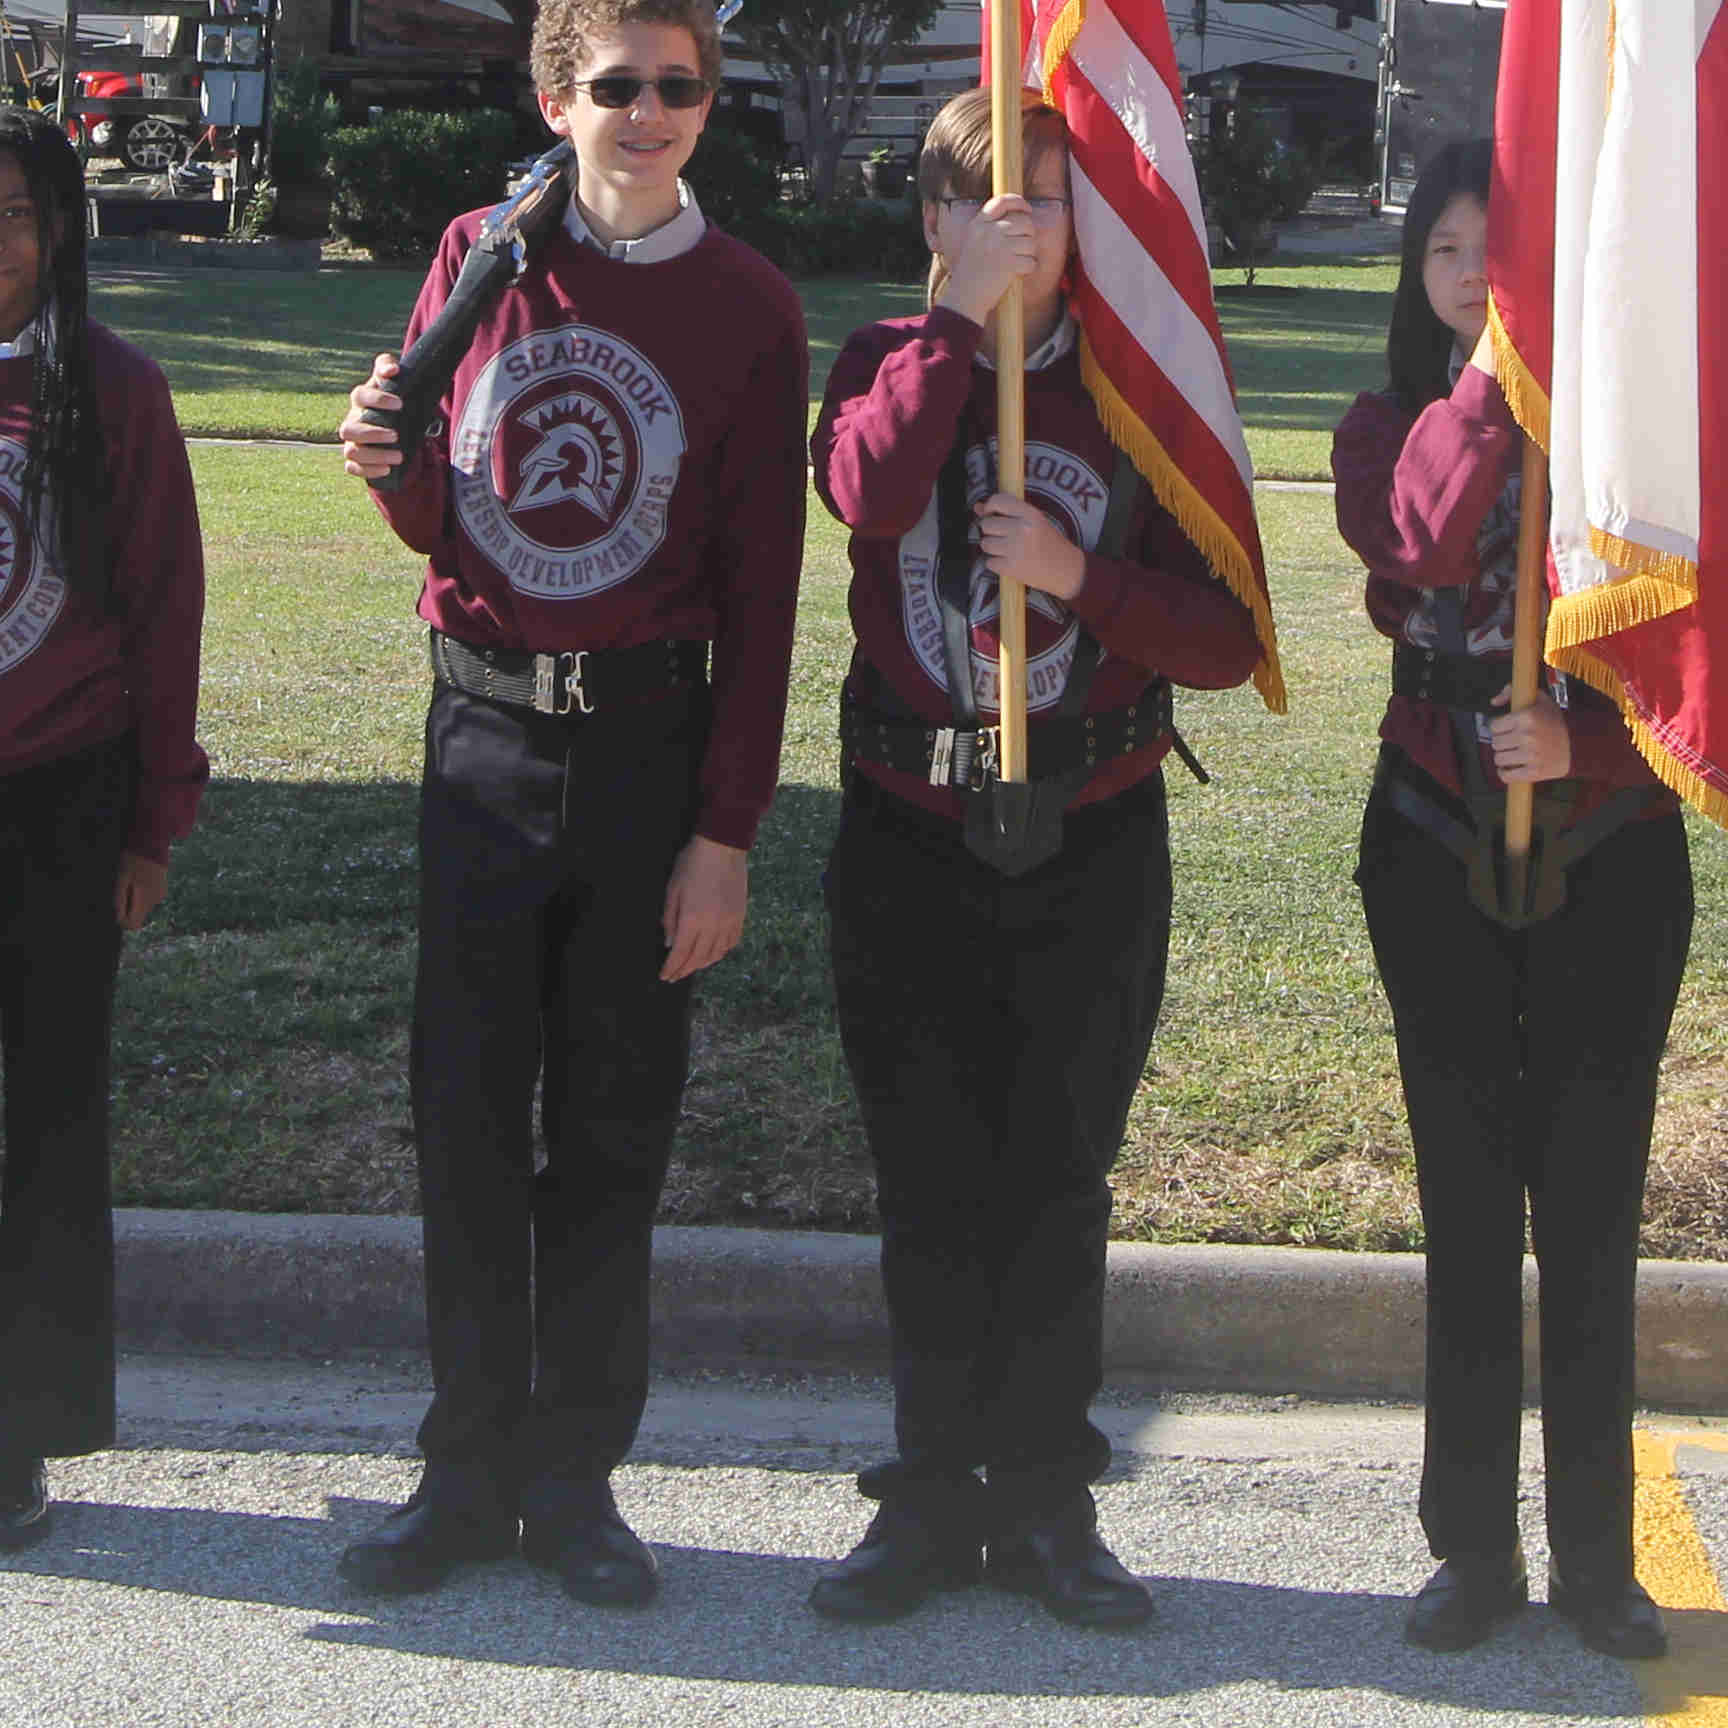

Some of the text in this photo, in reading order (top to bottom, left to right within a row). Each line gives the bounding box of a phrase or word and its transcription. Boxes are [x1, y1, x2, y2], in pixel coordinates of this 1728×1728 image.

[504, 338, 671, 426] SEABROOK
[508, 529, 644, 587] DEVELOPMENT
[25, 576, 64, 619] COR
